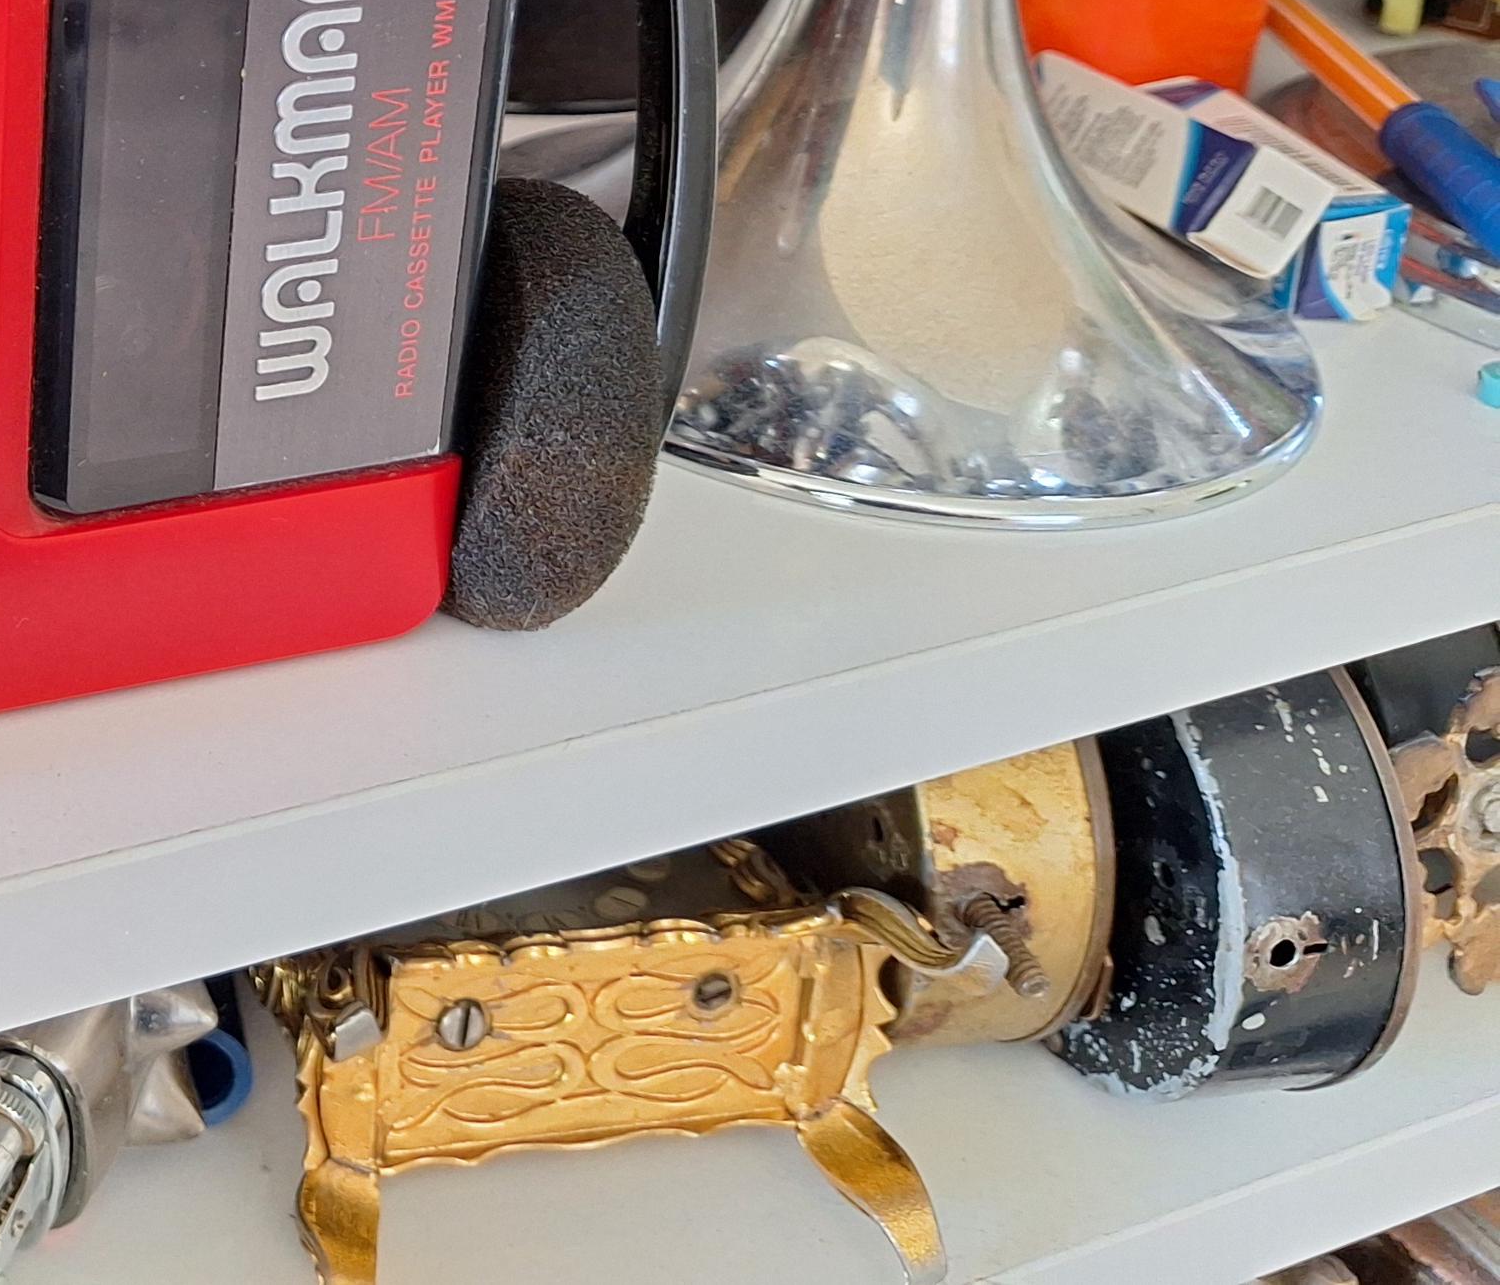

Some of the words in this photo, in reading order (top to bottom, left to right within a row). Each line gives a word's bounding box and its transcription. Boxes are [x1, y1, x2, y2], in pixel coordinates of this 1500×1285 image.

[356, 86, 413, 243] FM/AM
[417, 59, 452, 165] PLAYER
[402, 175, 438, 313] CASSETTE
[394, 318, 423, 400] RADIO
